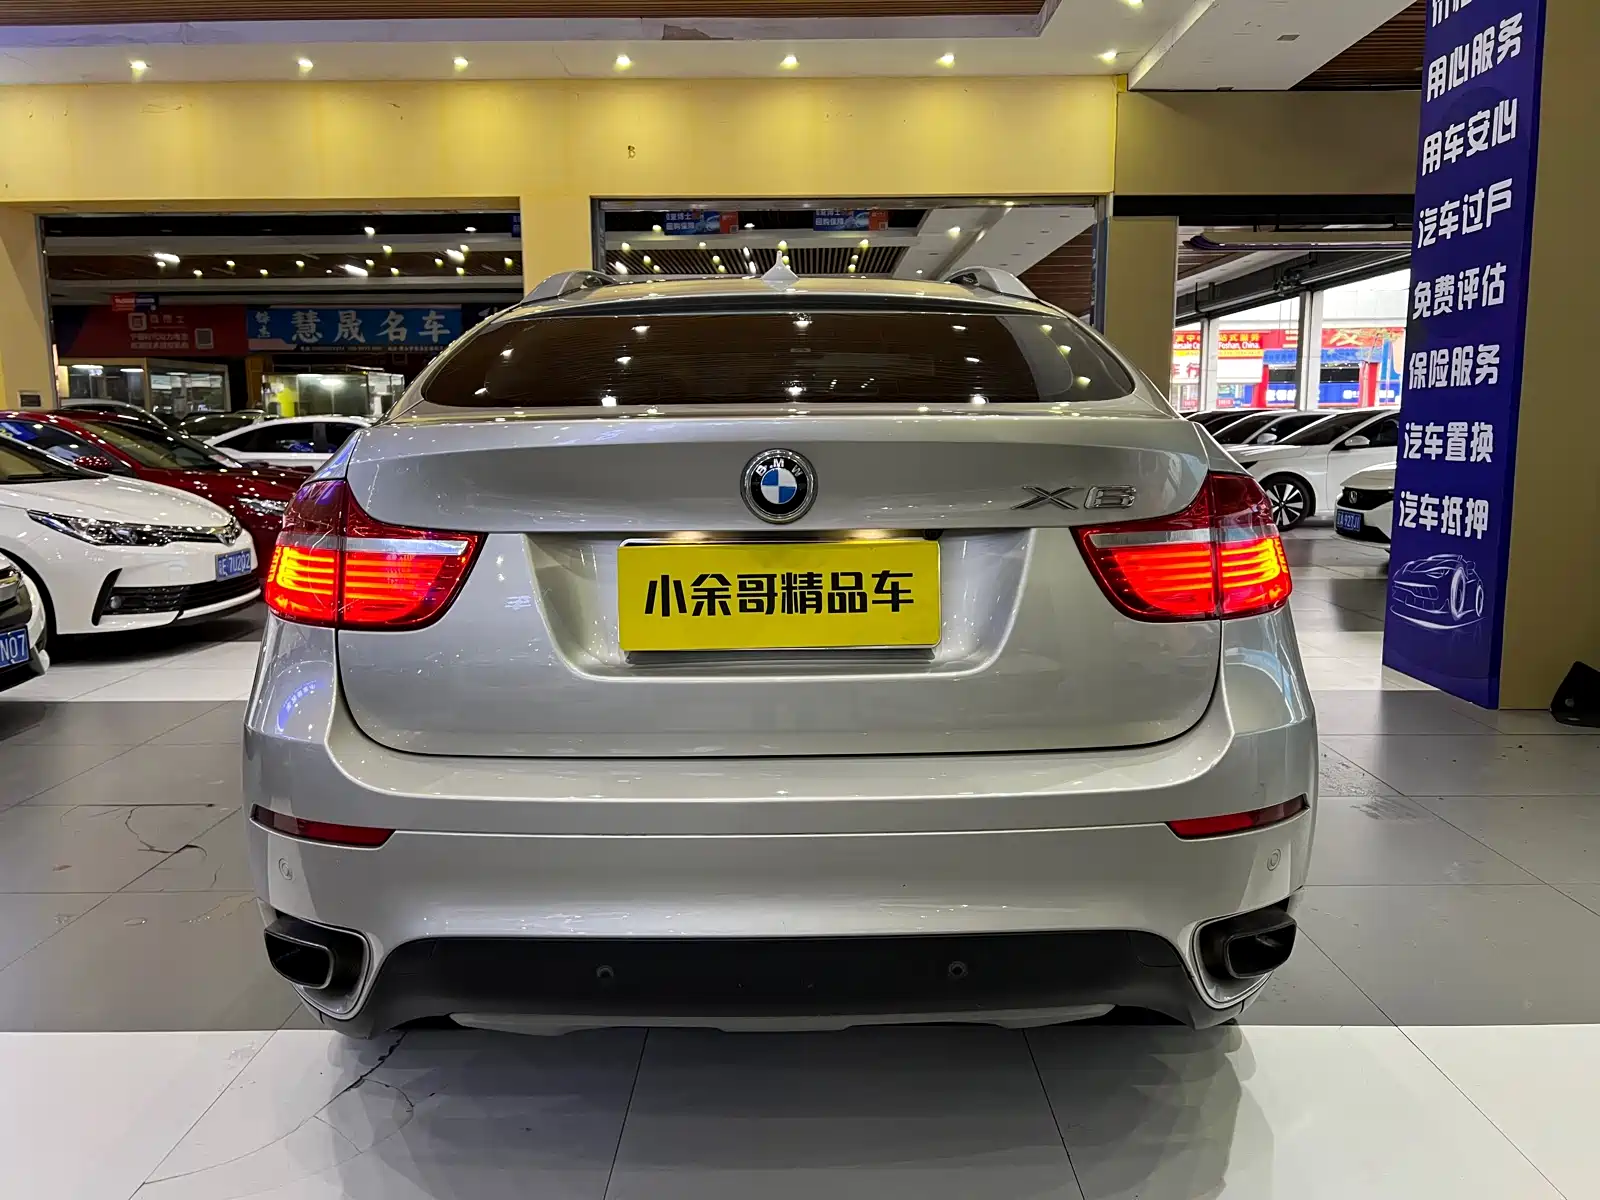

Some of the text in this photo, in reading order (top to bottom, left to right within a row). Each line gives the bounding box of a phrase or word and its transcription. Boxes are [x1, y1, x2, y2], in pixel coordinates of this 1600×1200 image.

[1427, 13, 1522, 102] 用心服务
[1422, 98, 1518, 176] 用车安心
[1417, 178, 1512, 248] 汽车过户
[1412, 262, 1507, 320] 免费评估
[291, 309, 450, 343] 慧晟名车
[1408, 344, 1500, 390] 保险服务
[1403, 421, 1494, 463] 汽车置换
[1010, 484, 1138, 511] X6
[1398, 490, 1489, 540] 汽车抵押
[644, 569, 914, 617] 小余哥精品车
